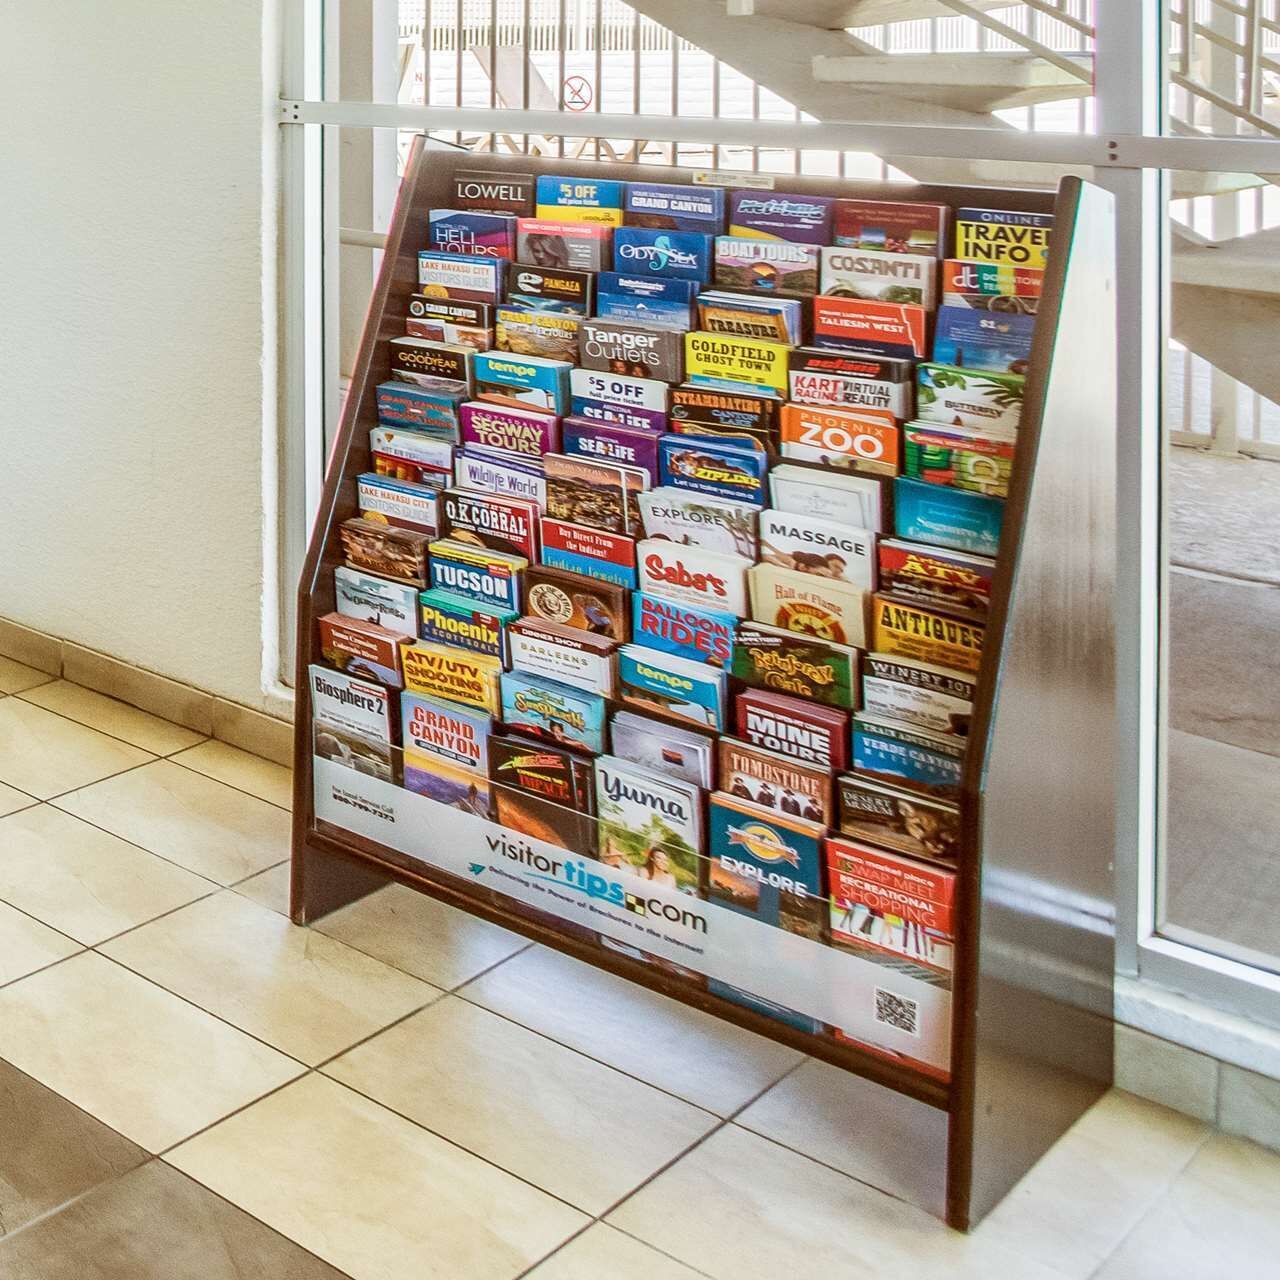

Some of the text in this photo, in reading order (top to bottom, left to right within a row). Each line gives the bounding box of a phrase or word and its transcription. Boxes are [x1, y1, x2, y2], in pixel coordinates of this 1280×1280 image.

[457, 183, 526, 202] LOWELL
[575, 185, 597, 199] OFF
[632, 197, 713, 214] GRAND CANYON
[981, 212, 1041, 226] ONLINE
[436, 228, 474, 244] HELI
[720, 241, 810, 263] BOAT TOURS
[963, 241, 1031, 263] INFO
[421, 261, 439, 271] LAKE
[473, 267, 490, 277] CITY
[829, 255, 921, 280] COSANTI
[536, 315, 578, 332] CANYON
[708, 319, 779, 338] TREASURE
[872, 321, 905, 333] WEST
[584, 326, 659, 349] Tanger
[398, 351, 458, 370] GOODYEAR
[585, 341, 660, 367] Outlets
[691, 339, 776, 363] GOLDFIELD
[695, 352, 772, 373] GHOST TOWN
[487, 359, 537, 378] tempe
[589, 376, 644, 398] $5 OFF
[794, 375, 891, 398] KART VIRTUAL
[794, 388, 890, 409] RACING REALITY
[944, 399, 1002, 418] BUTTERFLY
[470, 415, 544, 443] SEGWAY
[800, 412, 884, 439] PHOENIX
[475, 428, 542, 457] TOURS
[800, 420, 884, 460] ZOO
[468, 464, 539, 498] Wildlife World
[360, 486, 431, 509] LAKE HAVASU CITY
[472, 503, 529, 538] CORRAL
[651, 506, 724, 527] EXPLORE
[559, 526, 614, 549] Buy Direct From
[566, 540, 608, 559] the Indians!
[769, 522, 866, 557] MASSAGE
[433, 562, 508, 600] TUCSON
[645, 553, 727, 597] Saba's
[900, 560, 984, 586] ATV
[774, 583, 794, 600] Hall
[810, 595, 845, 617] Flame
[422, 606, 499, 646] Phoenix
[641, 597, 729, 638] BALLOON
[881, 604, 986, 652] ANTIQUES
[432, 627, 500, 656] SCOTTSDALE
[521, 628, 583, 649] DINNER SHOW
[641, 611, 730, 661] RIDES
[520, 641, 589, 667] BARLEENS
[405, 663, 483, 693] SHOOTING
[636, 662, 694, 691] tempe
[869, 660, 972, 697] WINERY 101
[315, 675, 385, 716] Biosphere 2
[413, 704, 475, 740] GRAND
[746, 711, 831, 754] MINE
[408, 720, 481, 760] CANYON
[746, 729, 832, 768] TOURS
[862, 736, 962, 773] VERDE CANYON
[730, 752, 820, 798] TOMBSTONE
[600, 769, 689, 821] Yuma
[488, 865, 531, 889] Delivering
[547, 887, 576, 905] Power
[720, 854, 813, 899] EXPLORE
[894, 876, 934, 899] MEET
[903, 873, 936, 888] place
[839, 873, 936, 914] RECREATIONAL
[840, 883, 937, 928] SHOPPING
